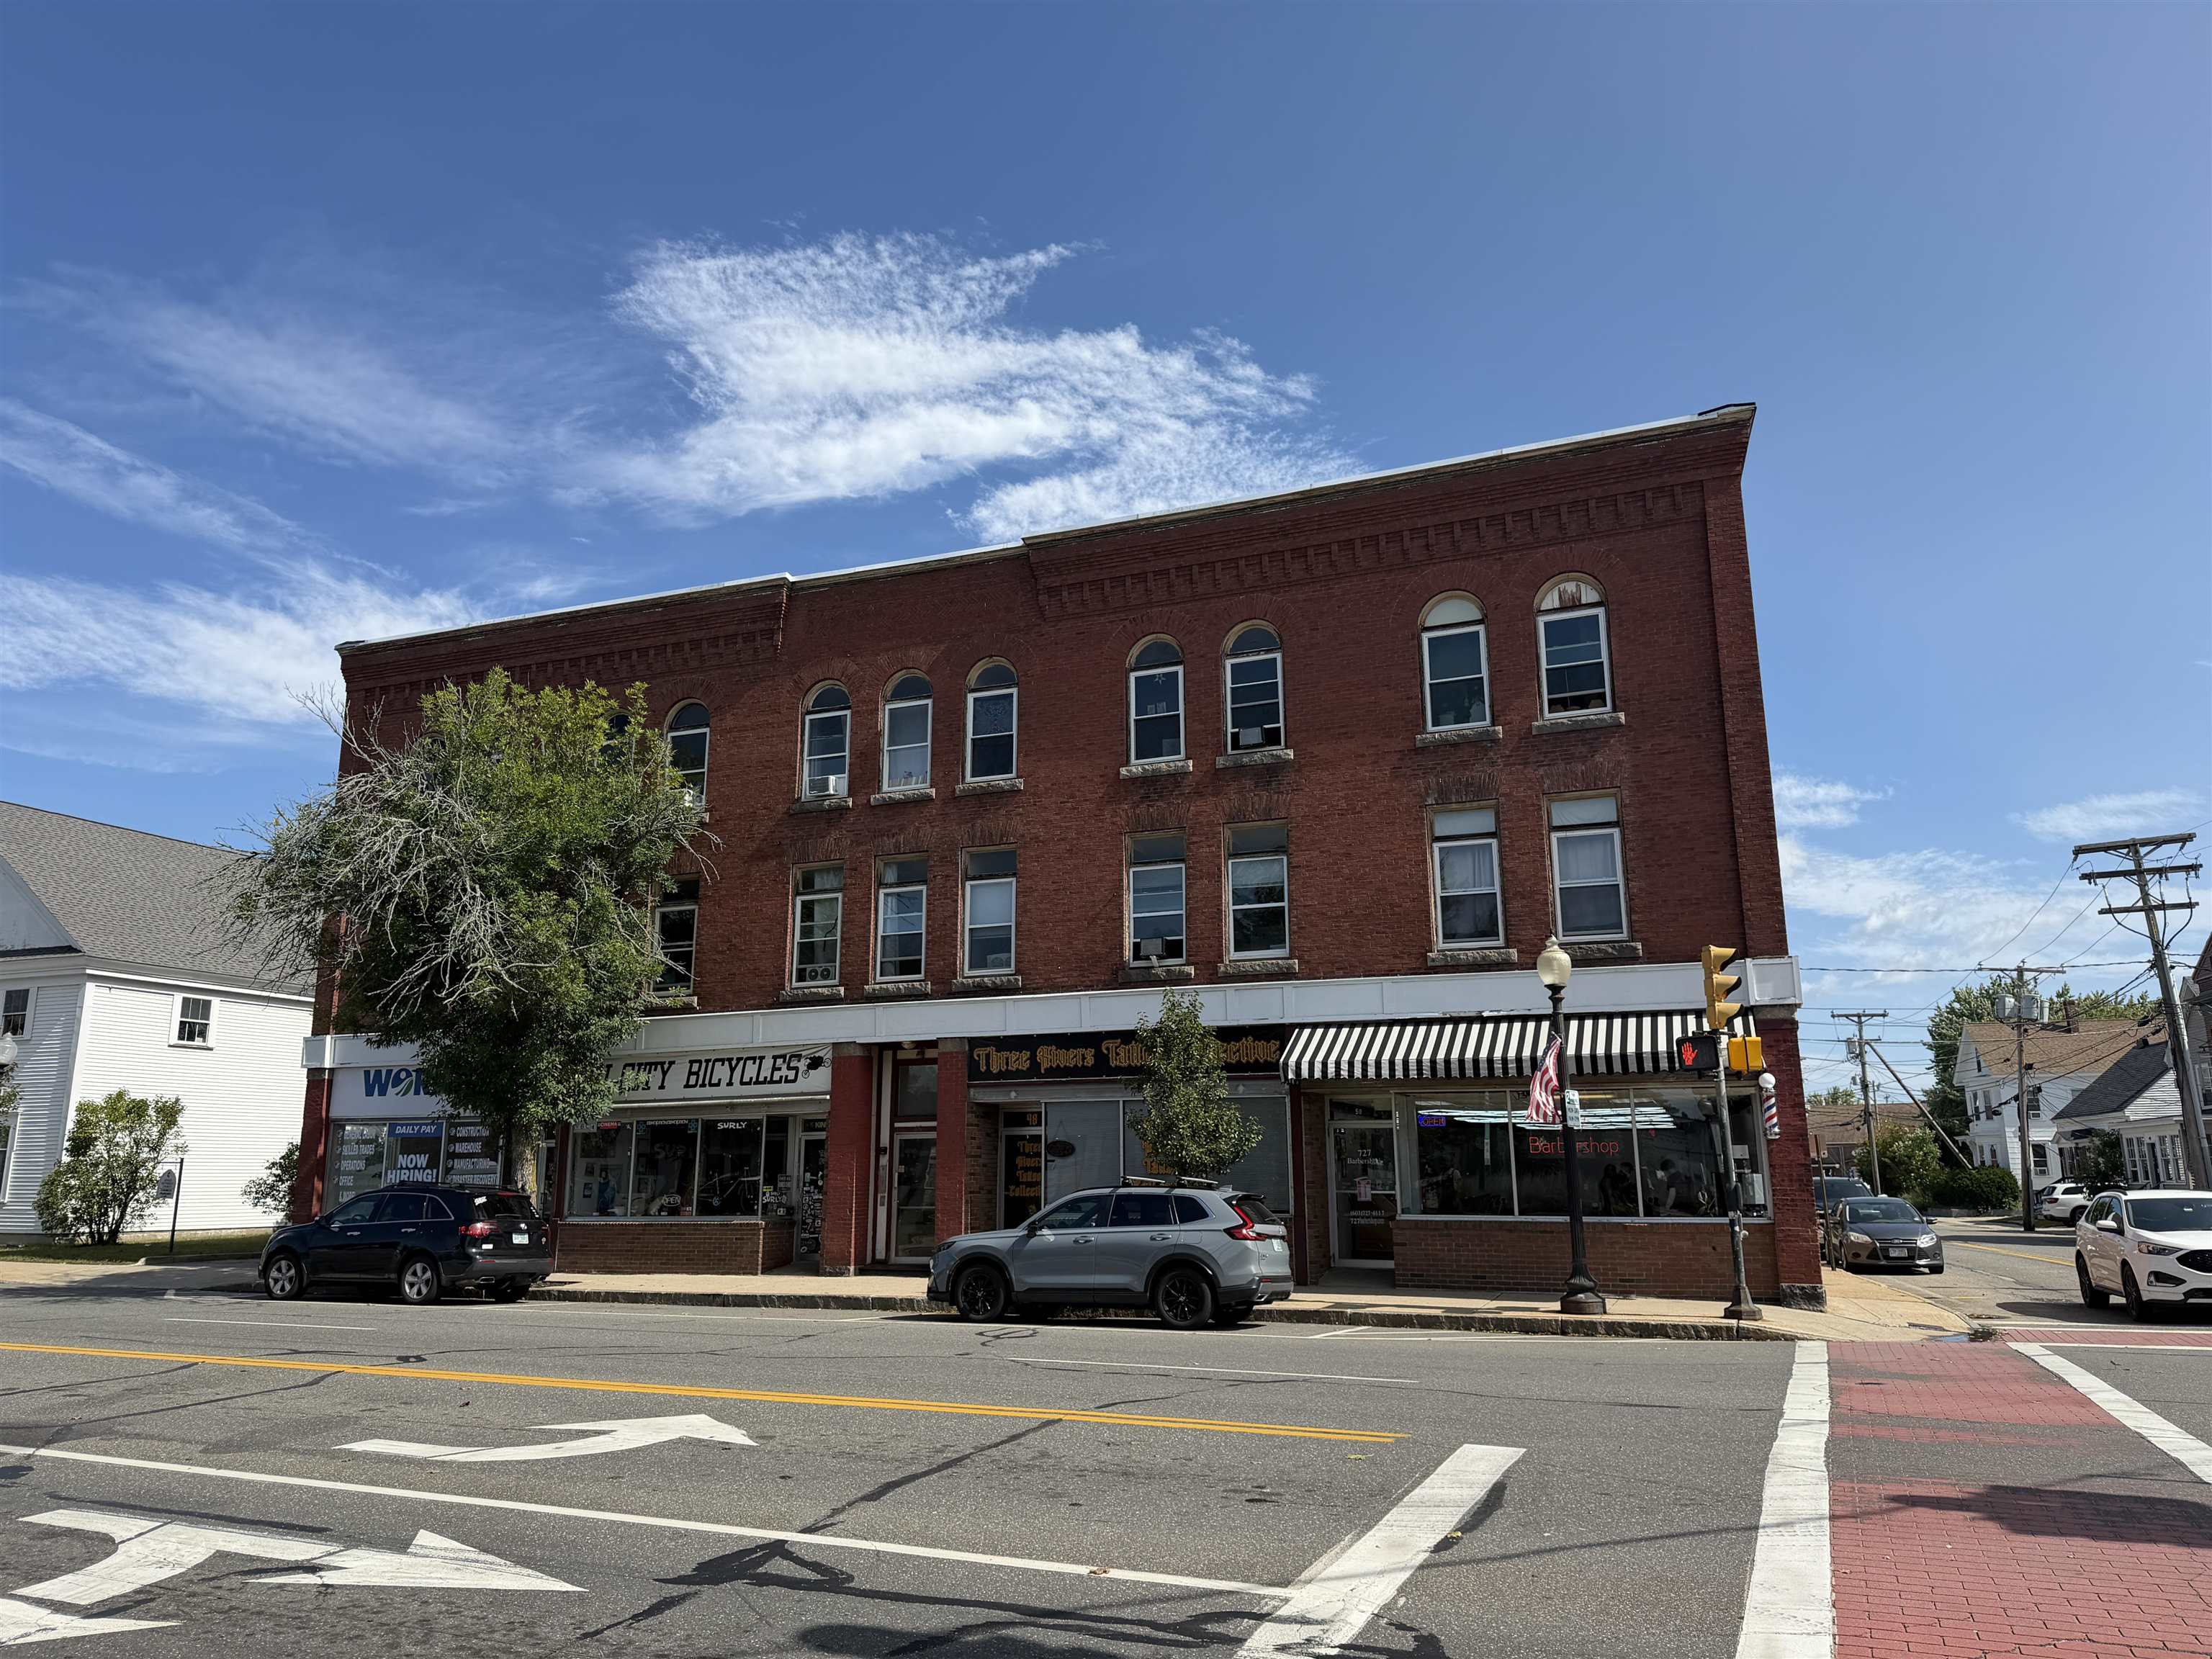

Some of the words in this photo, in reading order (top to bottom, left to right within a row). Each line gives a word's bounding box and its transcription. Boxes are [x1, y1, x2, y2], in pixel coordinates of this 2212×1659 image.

[974, 1047, 1031, 1073] Three
[1037, 1046, 1094, 1074] Rivers
[683, 1053, 802, 1089] BICYCLES
[395, 1125, 420, 1134] DAILY
[421, 1125, 436, 1133] PAY
[457, 1126, 490, 1137] CONSTRUCTION
[359, 1144, 375, 1155] TRADES
[455, 1142, 482, 1153] WAREHOUSE
[341, 1160, 366, 1170] OPERATIONS
[398, 1154, 429, 1168] NOW
[454, 1158, 490, 1169] MANUFACTURING
[339, 1176, 354, 1186] OFFICE
[387, 1169, 437, 1183] HIRING!
